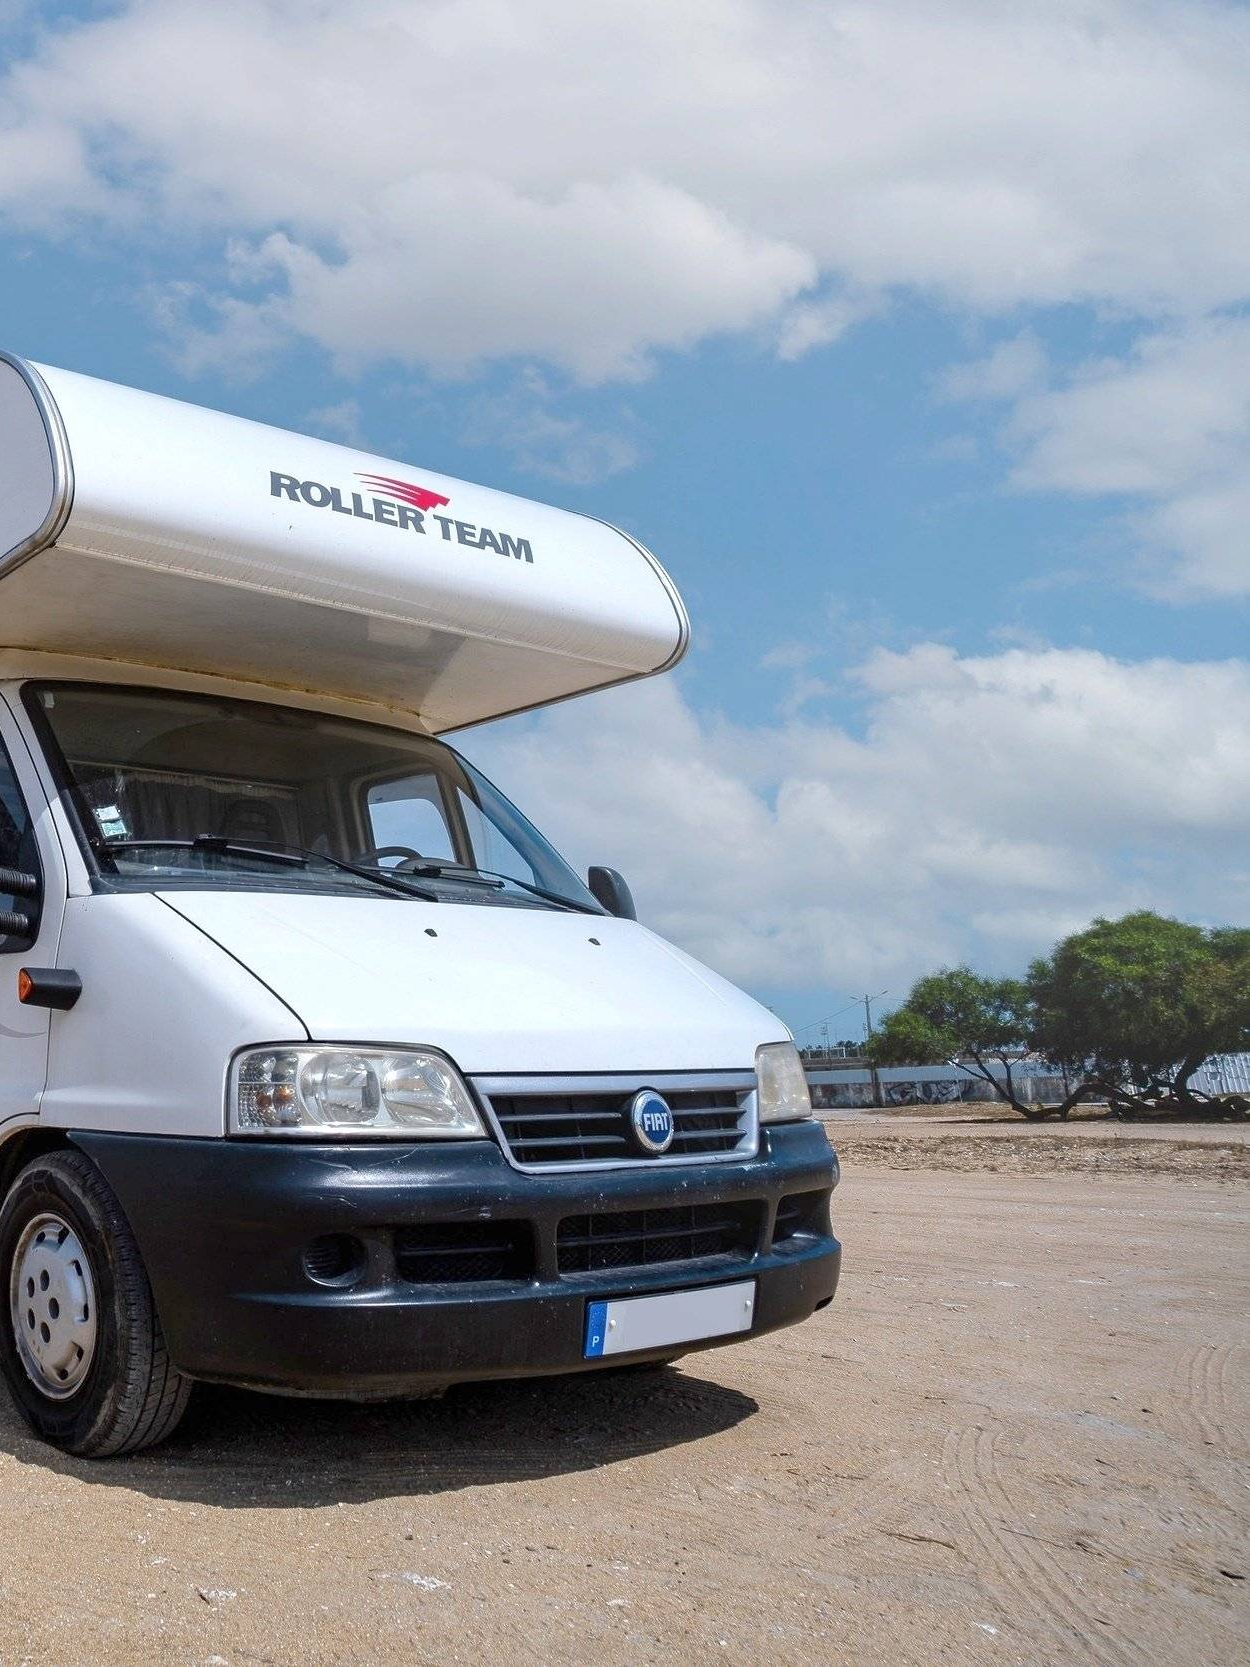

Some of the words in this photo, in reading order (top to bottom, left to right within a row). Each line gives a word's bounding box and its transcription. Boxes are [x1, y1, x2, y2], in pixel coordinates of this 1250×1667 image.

[269, 470, 427, 535] ROLLER
[432, 513, 534, 564] TEAM
[642, 1112, 669, 1131] FIAT
[592, 1335, 600, 1348] P
